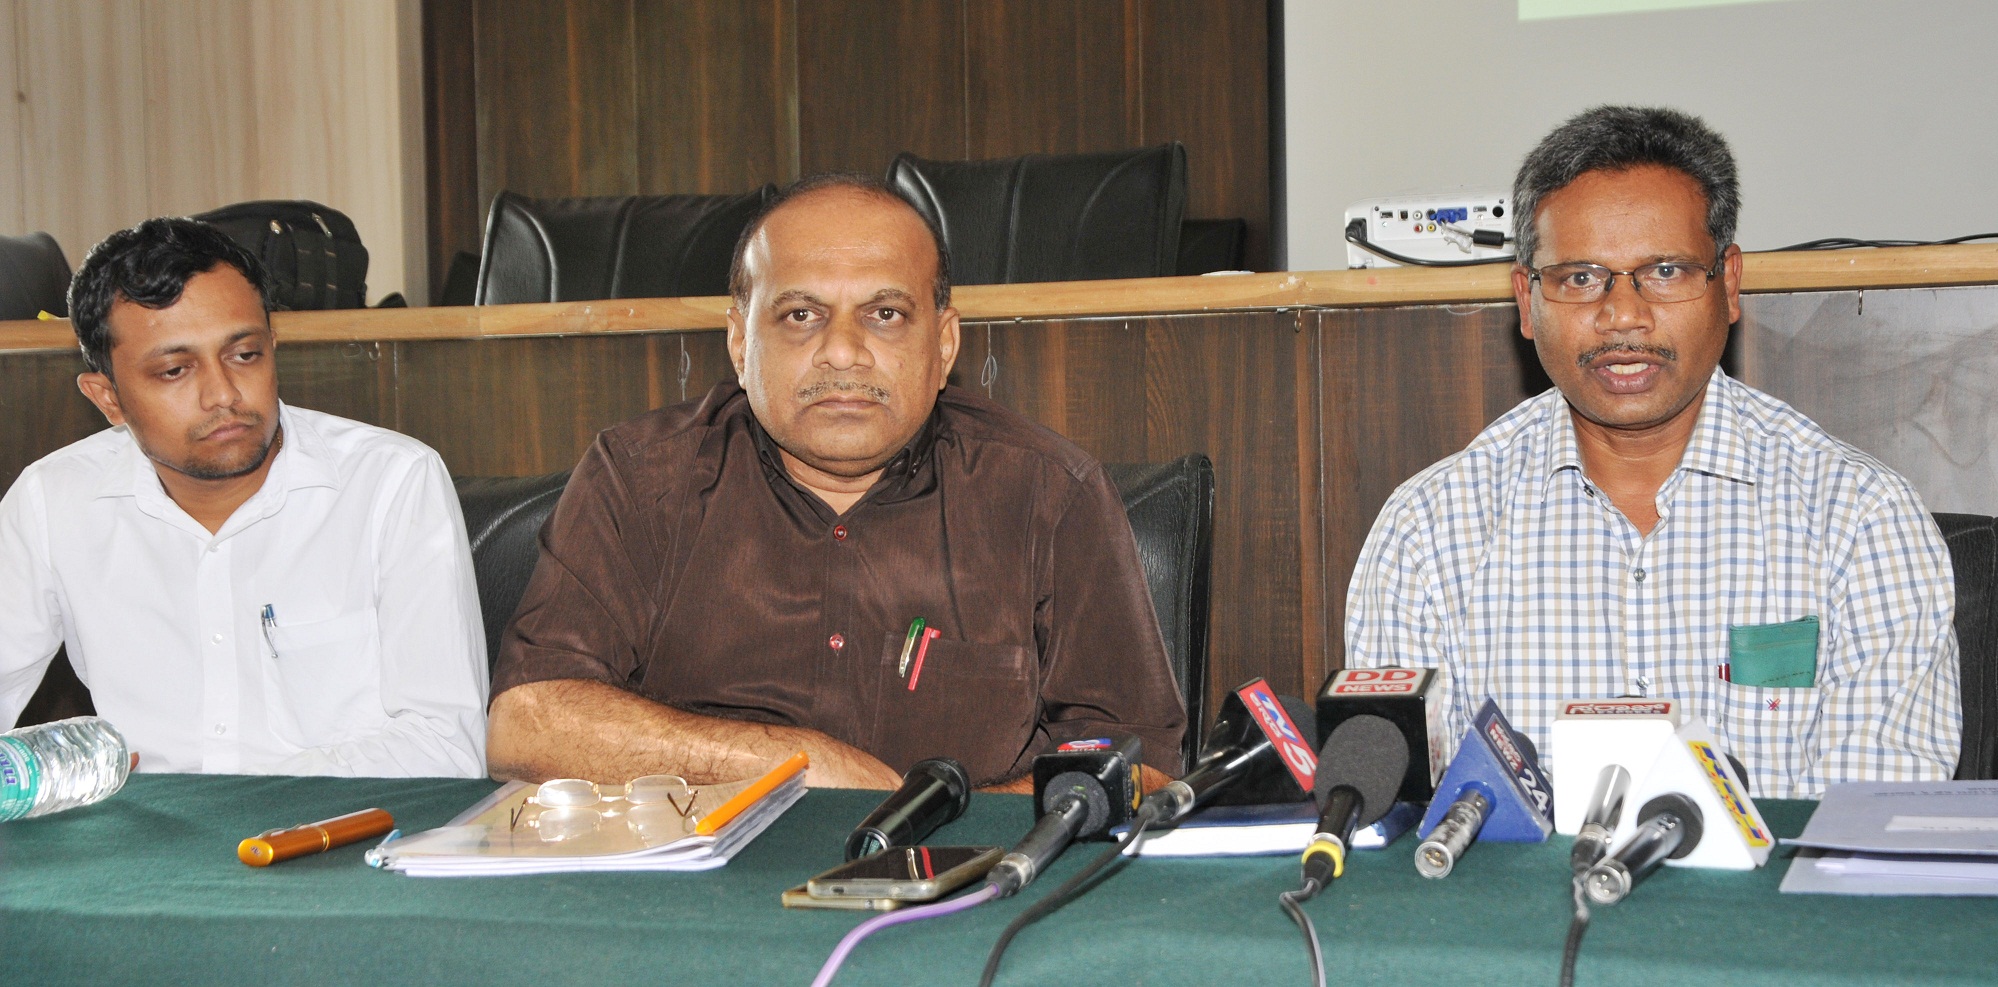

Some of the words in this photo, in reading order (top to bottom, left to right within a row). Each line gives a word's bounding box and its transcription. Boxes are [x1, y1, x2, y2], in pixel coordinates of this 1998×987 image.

[1345, 669, 1417, 682] DD
[1342, 683, 1408, 693] NEWS
[1518, 767, 1549, 812] 24
